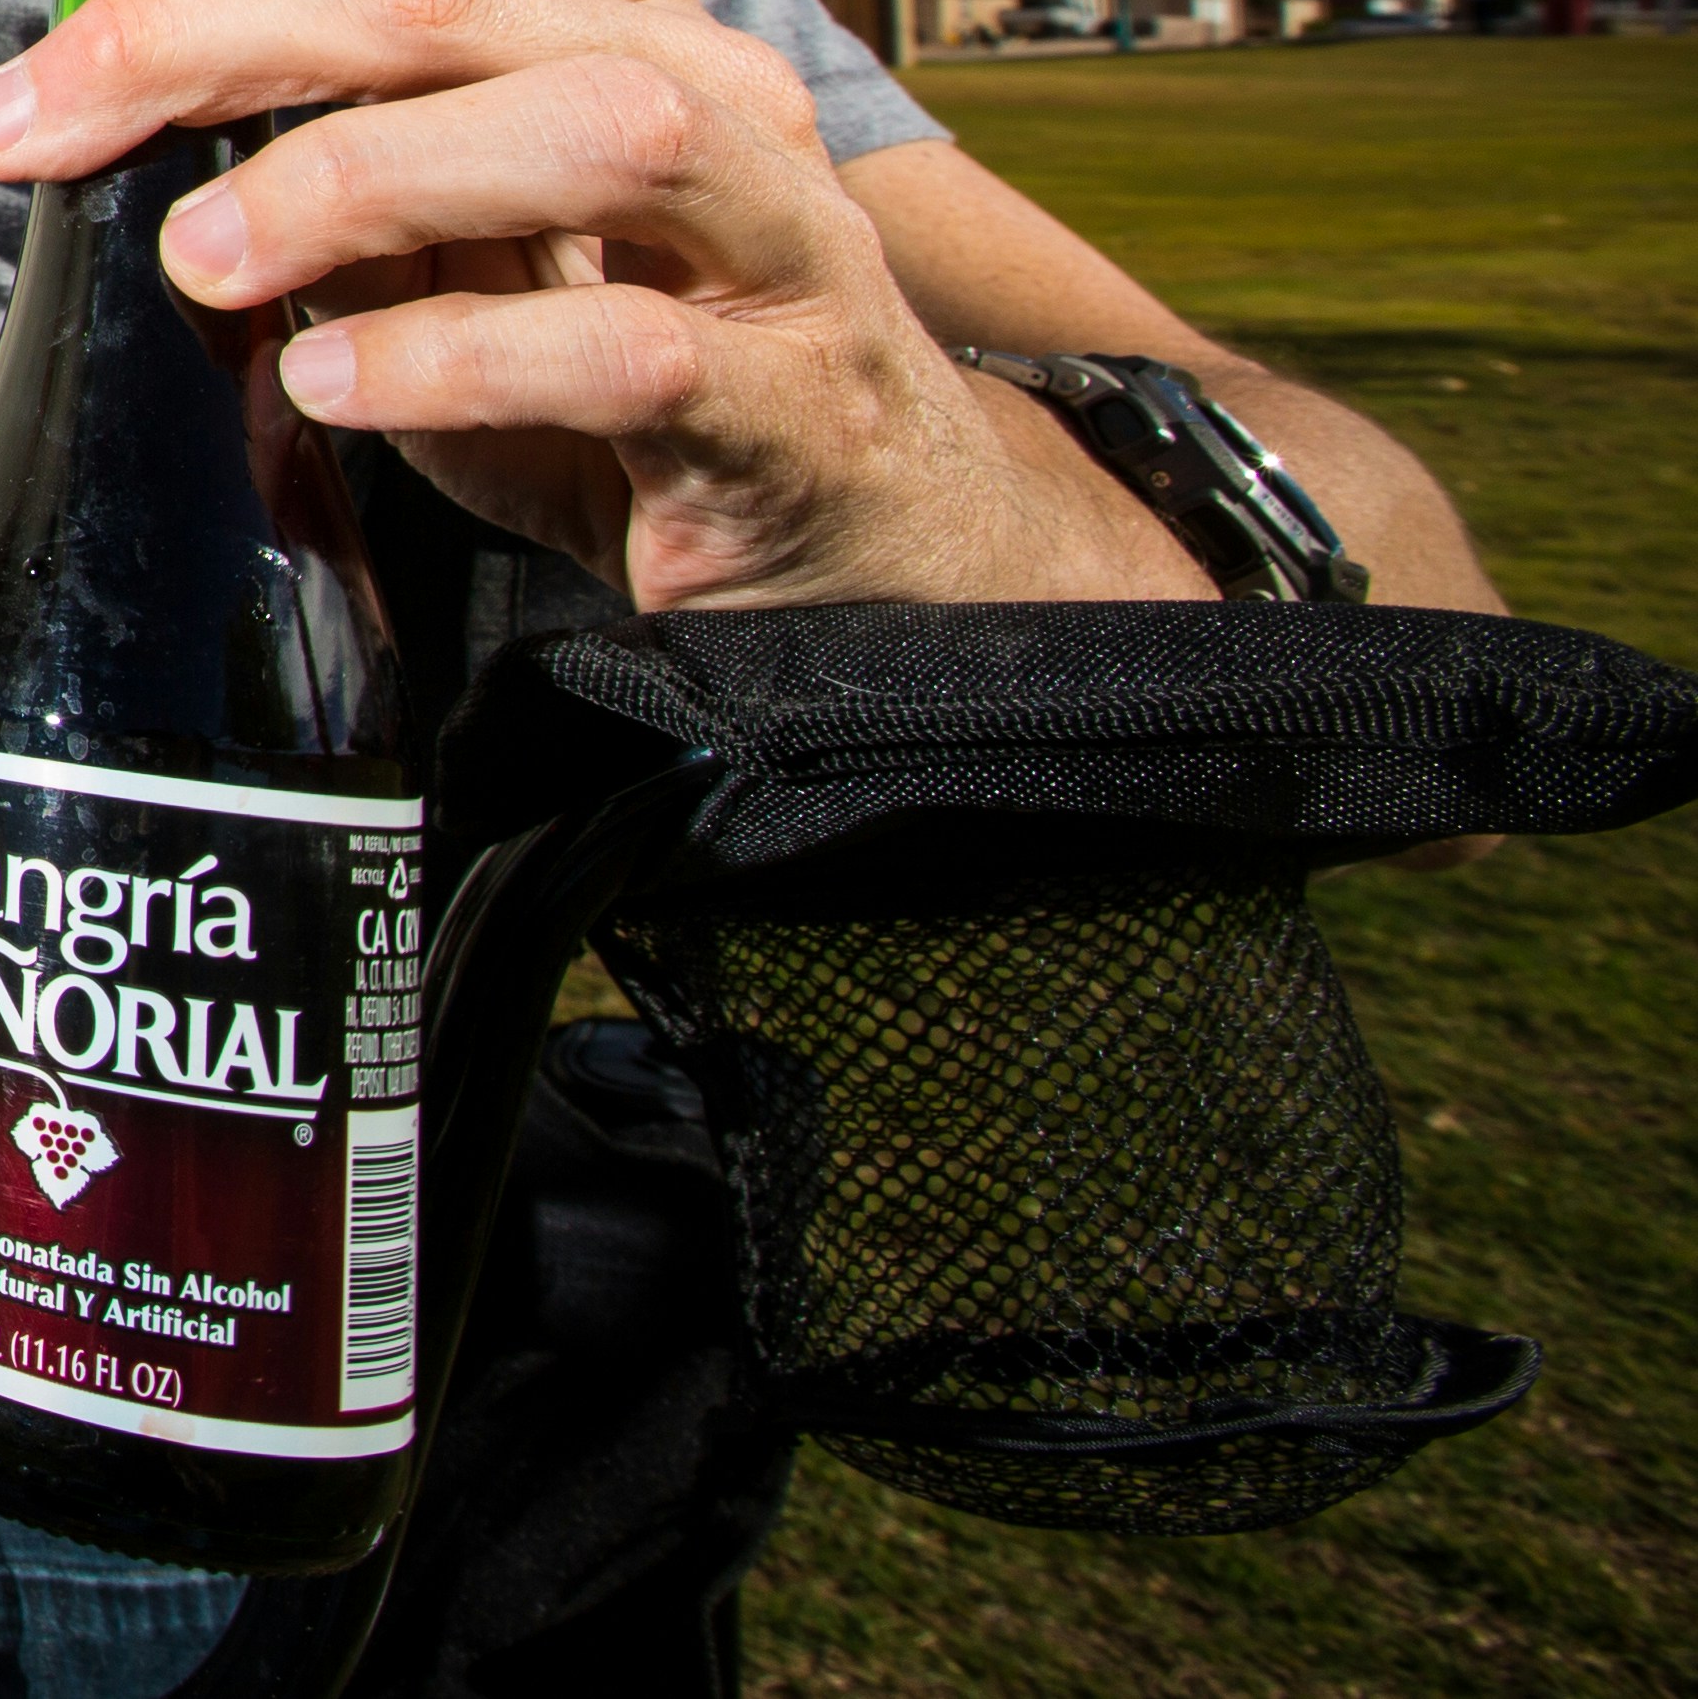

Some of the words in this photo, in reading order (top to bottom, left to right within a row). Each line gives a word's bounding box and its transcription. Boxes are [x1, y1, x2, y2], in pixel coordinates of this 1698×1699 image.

[357, 909, 389, 955] CA
[123, 1262, 172, 1296] Sin
[179, 1273, 291, 1312] Alcohol
[74, 1288, 96, 1318] Y
[103, 1298, 236, 1346] Artificial
[11, 1330, 87, 1382] (11.16
[95, 1353, 123, 1392] FL
[132, 1362, 183, 1408] OZ)
